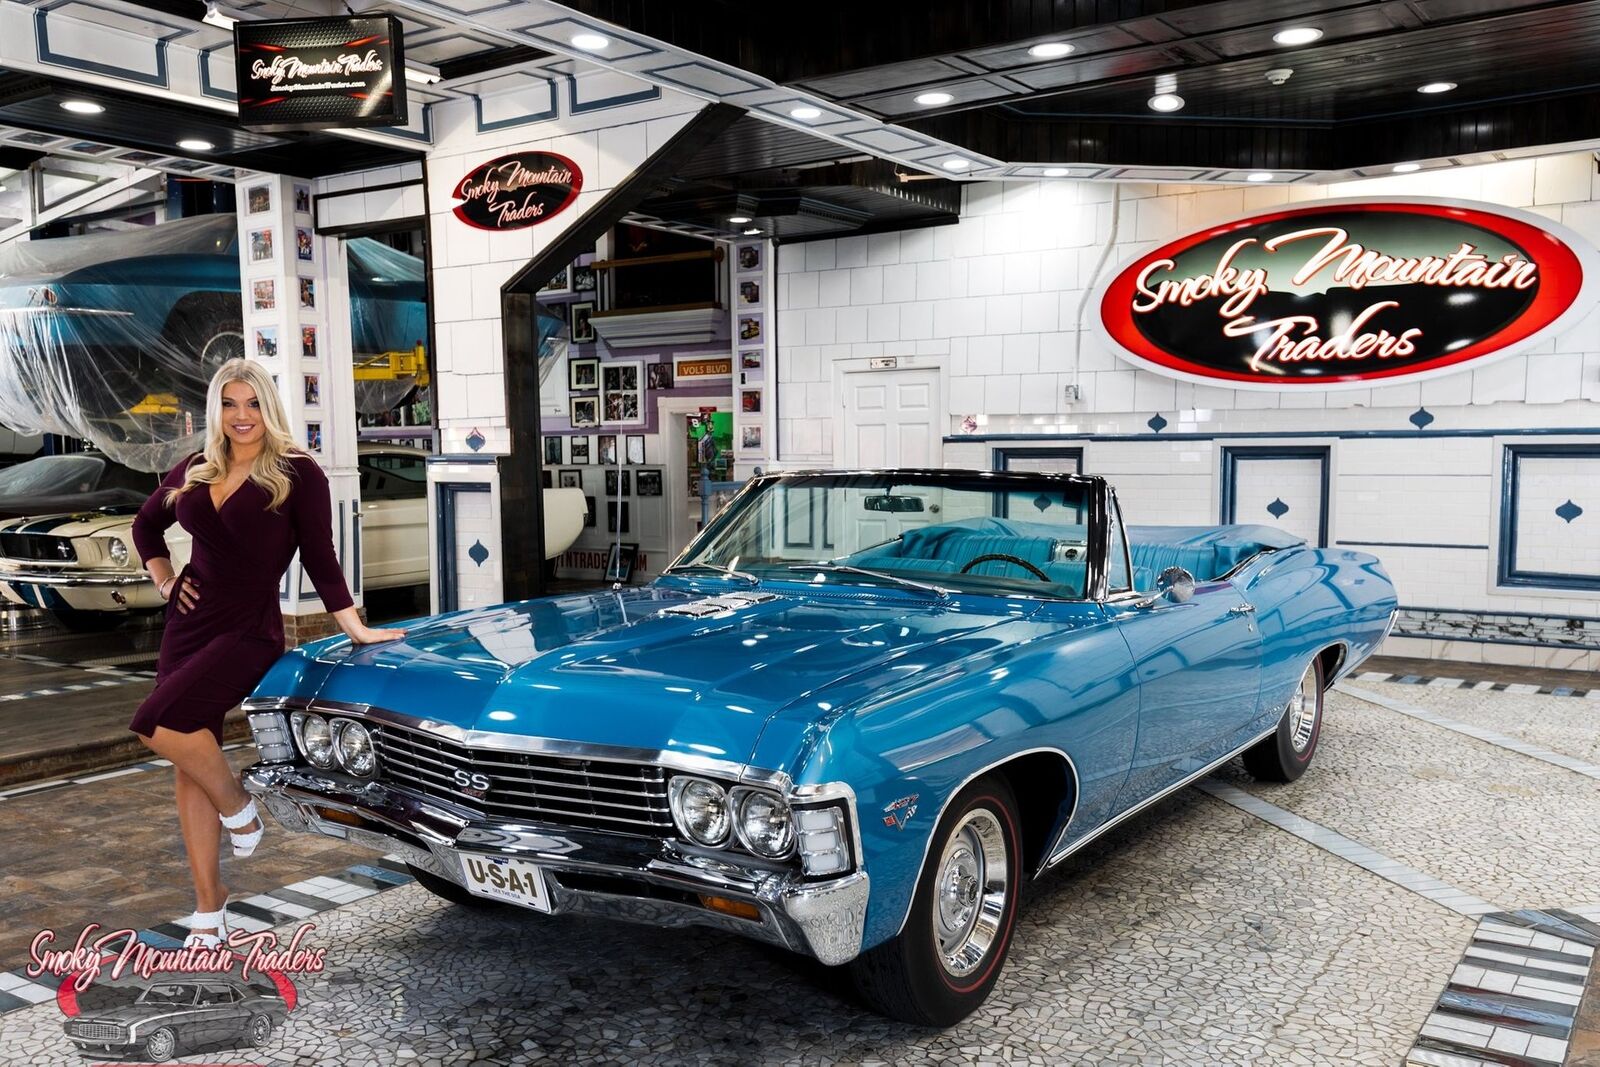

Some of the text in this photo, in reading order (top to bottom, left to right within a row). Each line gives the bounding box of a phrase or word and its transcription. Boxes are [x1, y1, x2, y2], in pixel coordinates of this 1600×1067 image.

[251, 49, 383, 84] Smoky Mountain Traders
[461, 160, 572, 203] Smoky Mountain
[488, 191, 545, 227] Traders
[1132, 226, 1538, 317] Smoky Mountain
[1223, 301, 1424, 372] Traders
[683, 364, 728, 375] VOLS BLVD
[454, 769, 490, 790] SS
